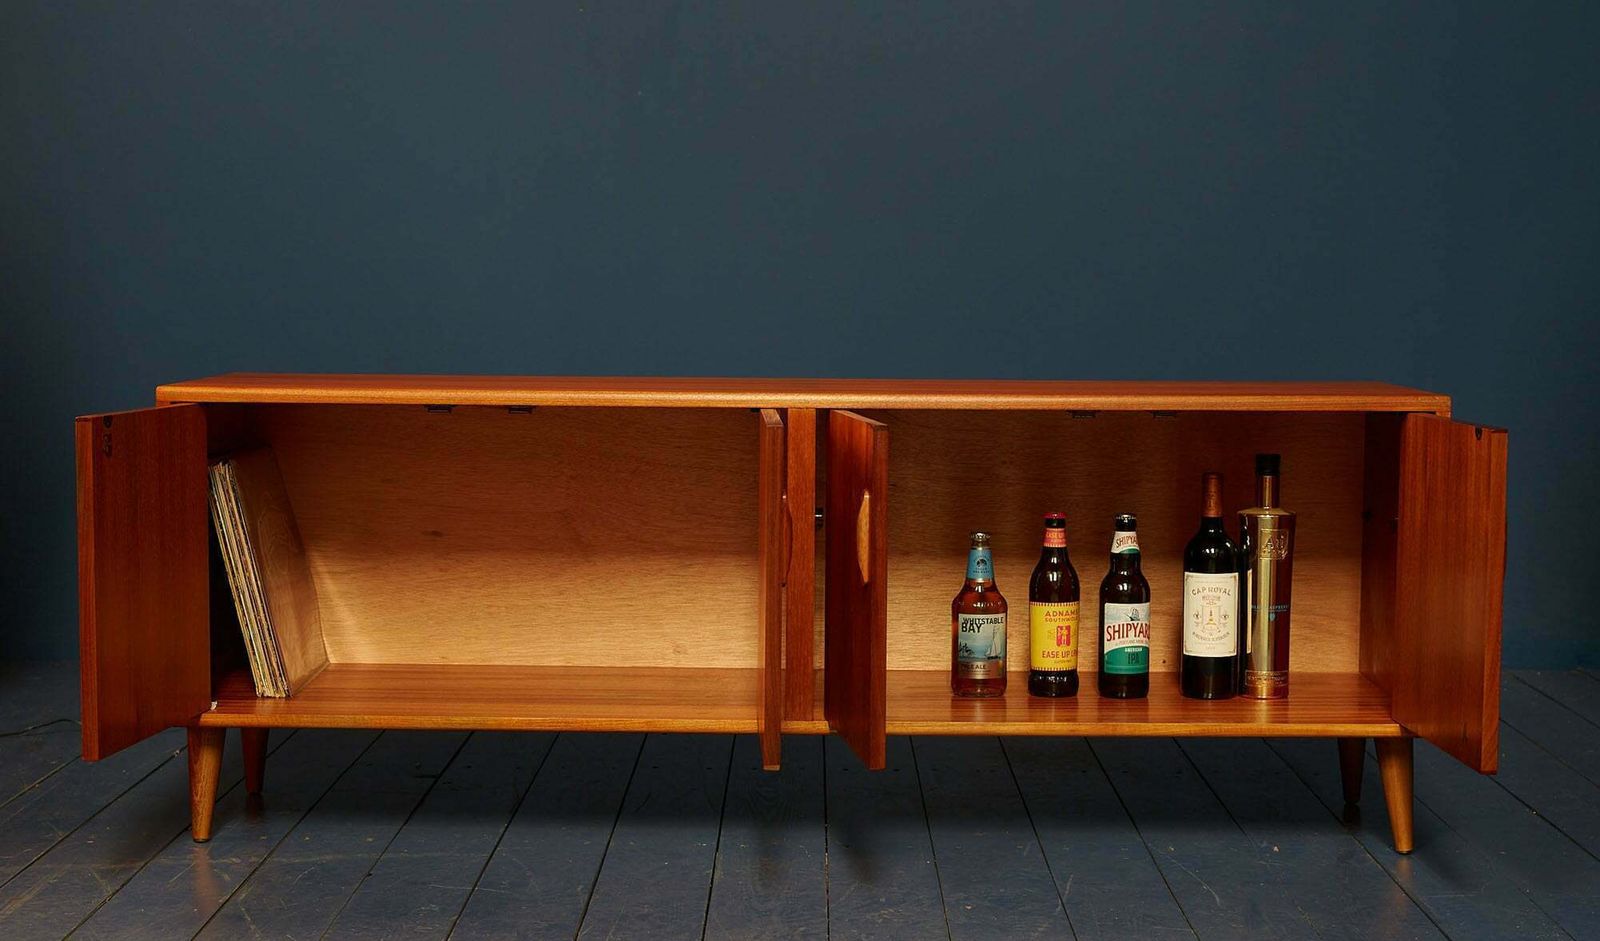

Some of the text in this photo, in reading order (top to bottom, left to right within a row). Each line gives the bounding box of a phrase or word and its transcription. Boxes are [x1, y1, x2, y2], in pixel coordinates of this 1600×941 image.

[1191, 586, 1207, 596] CAP
[962, 616, 1004, 625] WHITSTABLE
[961, 622, 982, 633] BAY
[1106, 622, 1150, 642] SHIPYAR
[1042, 650, 1060, 659] EASE
[1061, 650, 1071, 659] UP
[1127, 652, 1140, 665] IPA
